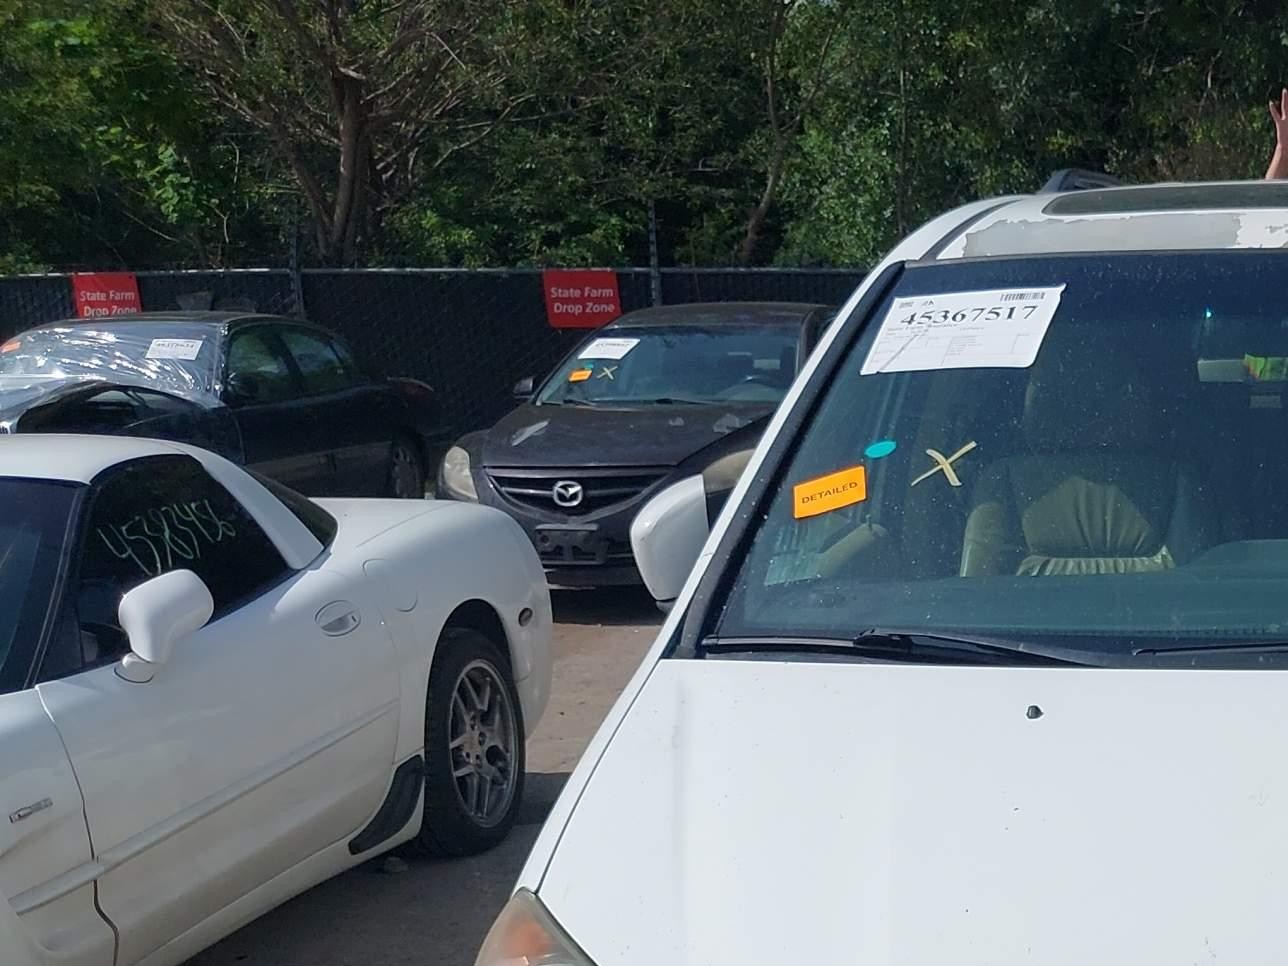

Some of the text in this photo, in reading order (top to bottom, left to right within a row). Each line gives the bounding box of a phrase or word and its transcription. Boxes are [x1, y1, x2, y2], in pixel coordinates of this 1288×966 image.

[80, 290, 135, 301] State Farm
[551, 287, 613, 298] State Farm
[83, 305, 109, 318] Drop
[553, 302, 615, 316] Drop Zone
[900, 305, 1039, 325] 45367517
[801, 481, 858, 504] DETAILED
